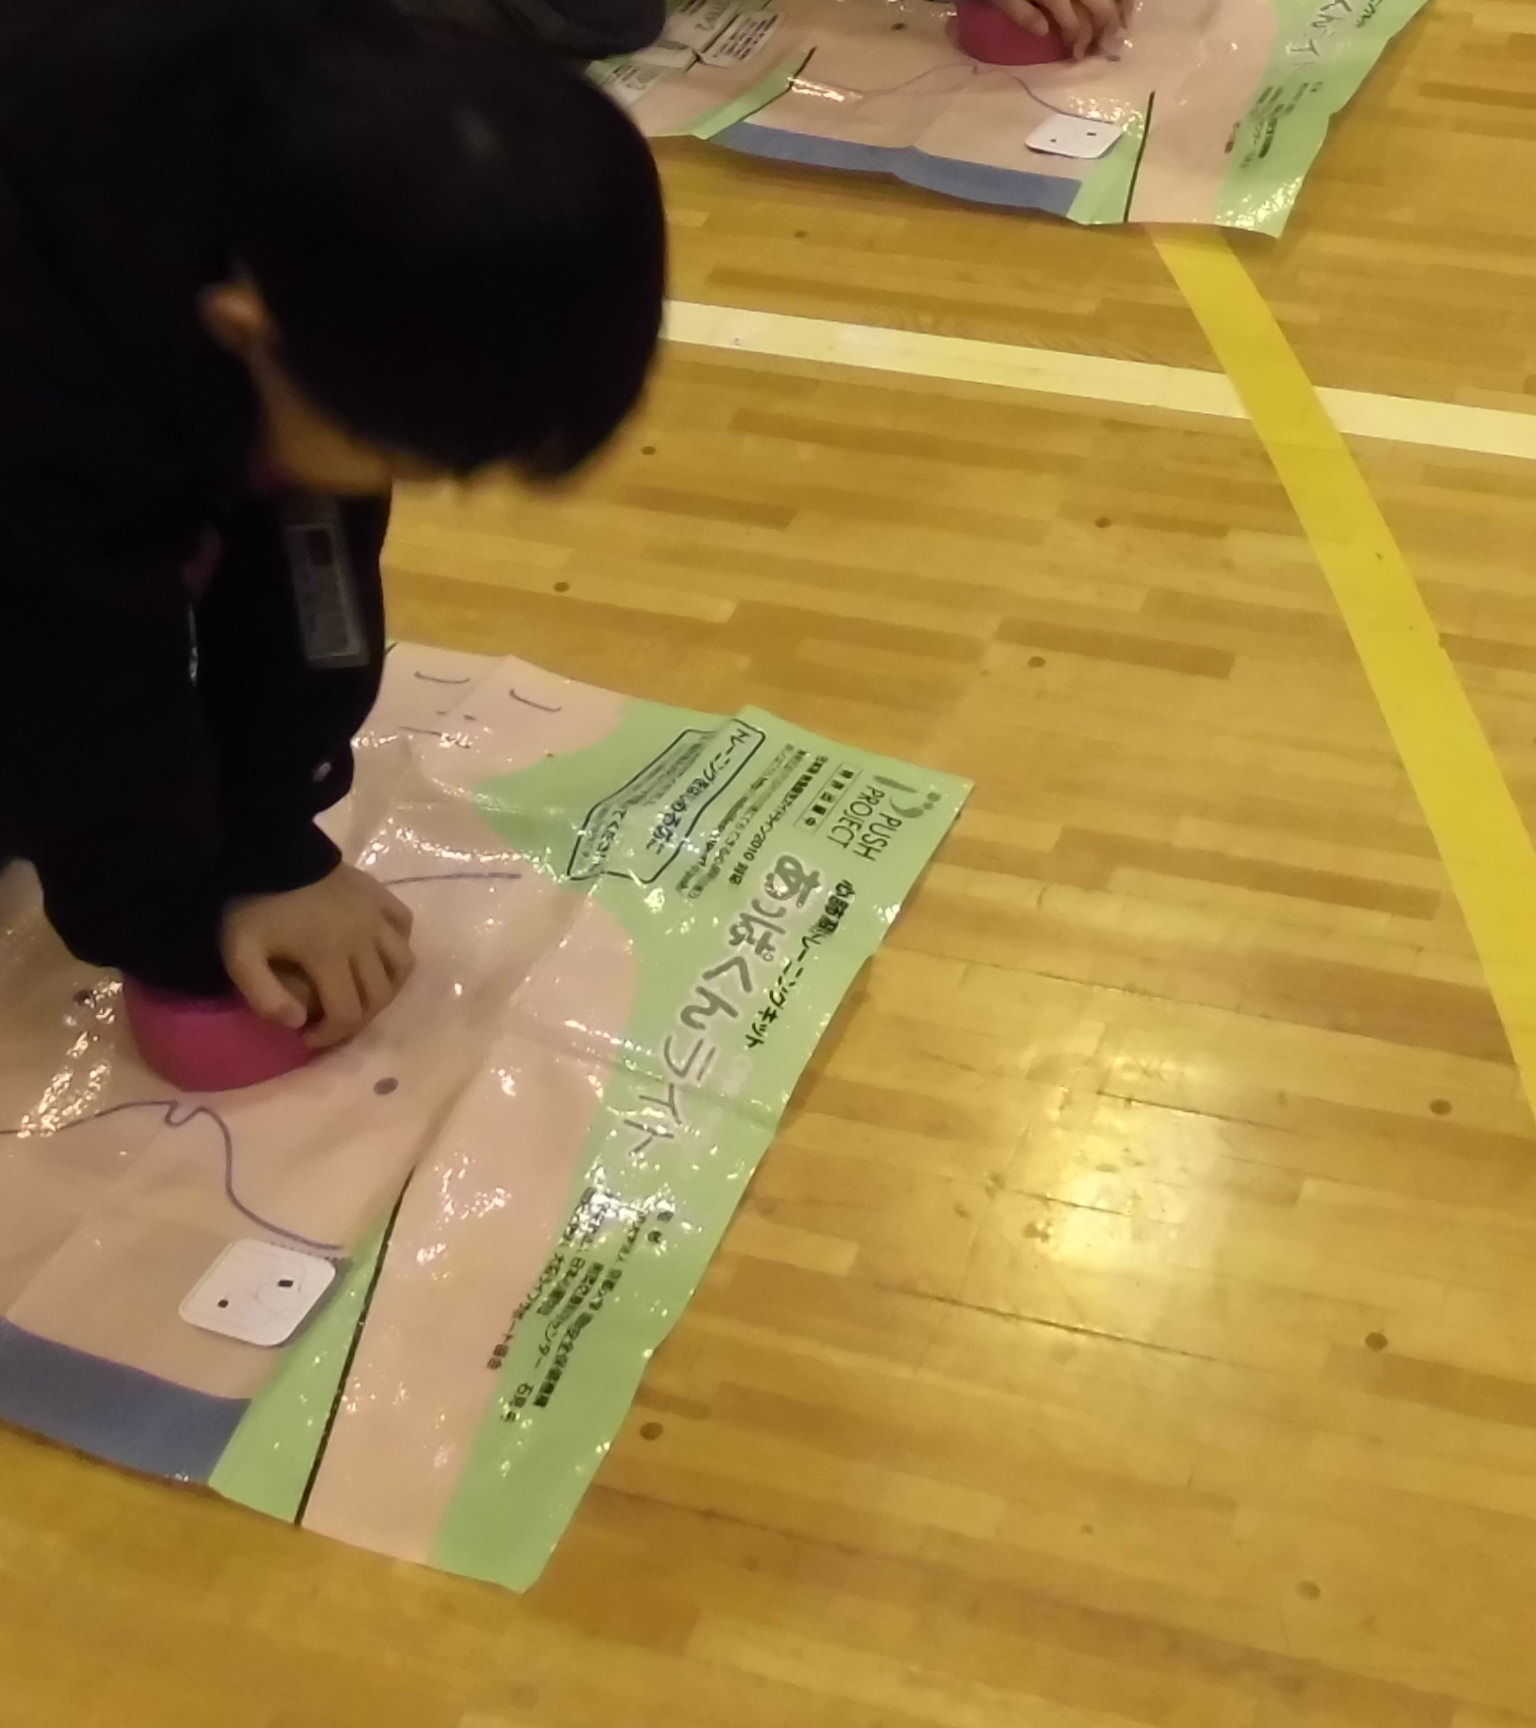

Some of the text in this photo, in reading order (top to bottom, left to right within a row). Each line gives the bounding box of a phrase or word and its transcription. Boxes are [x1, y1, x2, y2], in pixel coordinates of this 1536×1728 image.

[824, 784, 885, 849] PROJECT
[850, 811, 905, 861] PUSH
[623, 855, 824, 1155] あっぱくんライト
